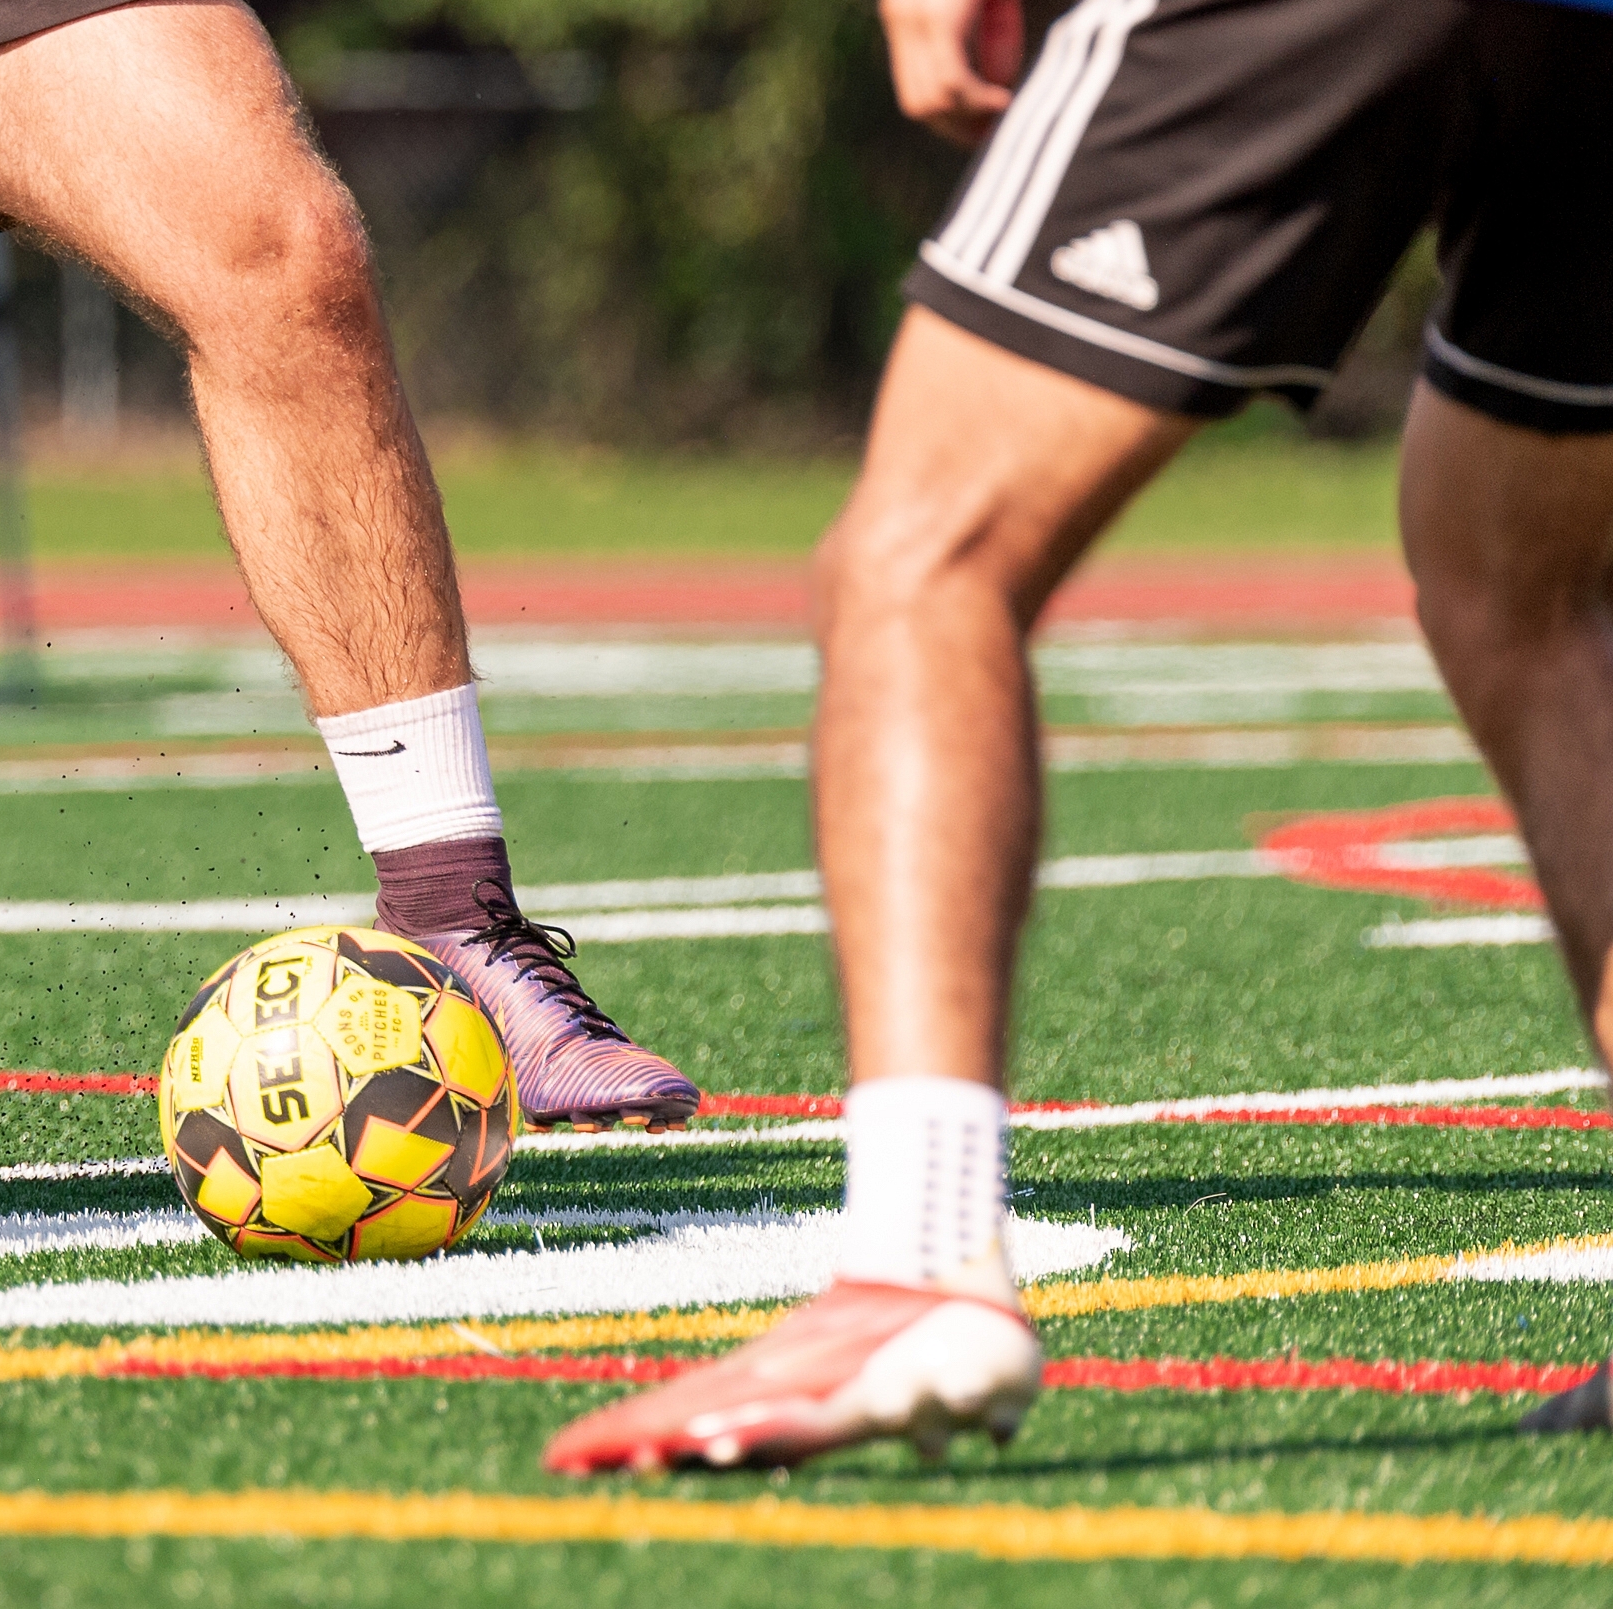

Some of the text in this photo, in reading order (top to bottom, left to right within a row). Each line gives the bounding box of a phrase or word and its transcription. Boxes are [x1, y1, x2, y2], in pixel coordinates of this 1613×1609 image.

[348, 988, 365, 1003] OF
[255, 955, 310, 1127] SELECT
[339, 1010, 366, 1057] SONS
[373, 988, 388, 1062] PITCHES
[392, 1018, 402, 1033] FC
